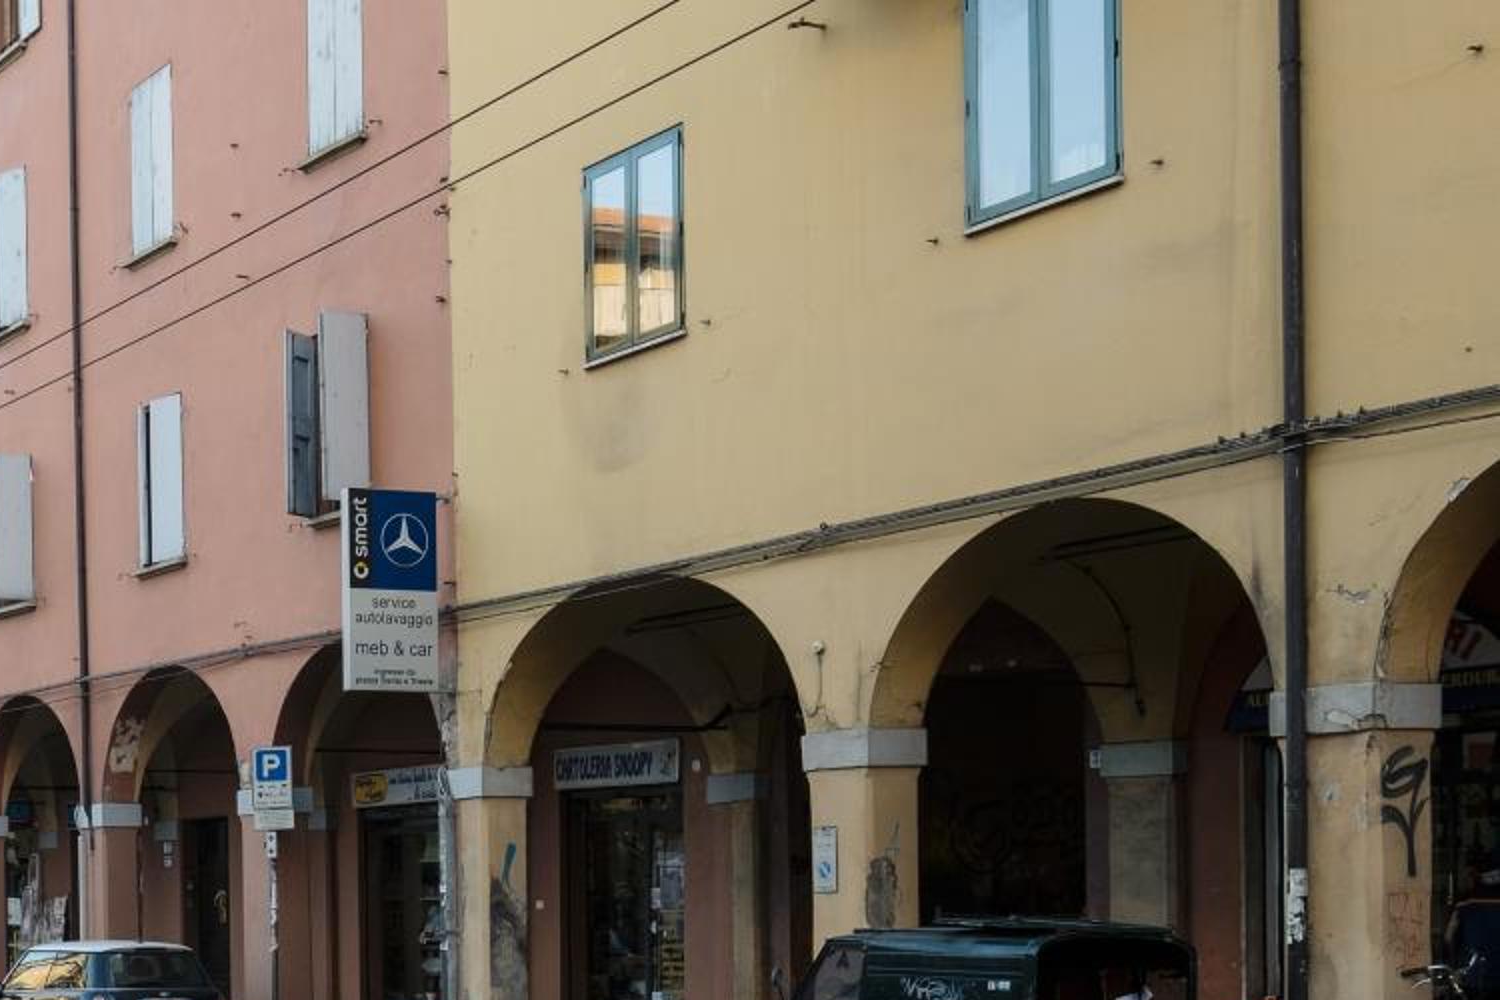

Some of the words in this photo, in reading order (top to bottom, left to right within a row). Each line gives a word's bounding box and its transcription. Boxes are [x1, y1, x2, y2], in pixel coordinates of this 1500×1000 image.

[353, 497, 369, 557] smart
[372, 597, 417, 609] service
[355, 610, 433, 629] autolavaggio
[355, 639, 389, 657] meb
[393, 640, 405, 657] &
[409, 642, 433, 657] car
[262, 753, 280, 778] P
[556, 754, 612, 781] CARTOLERIA
[613, 750, 653, 778] SNOOPY
